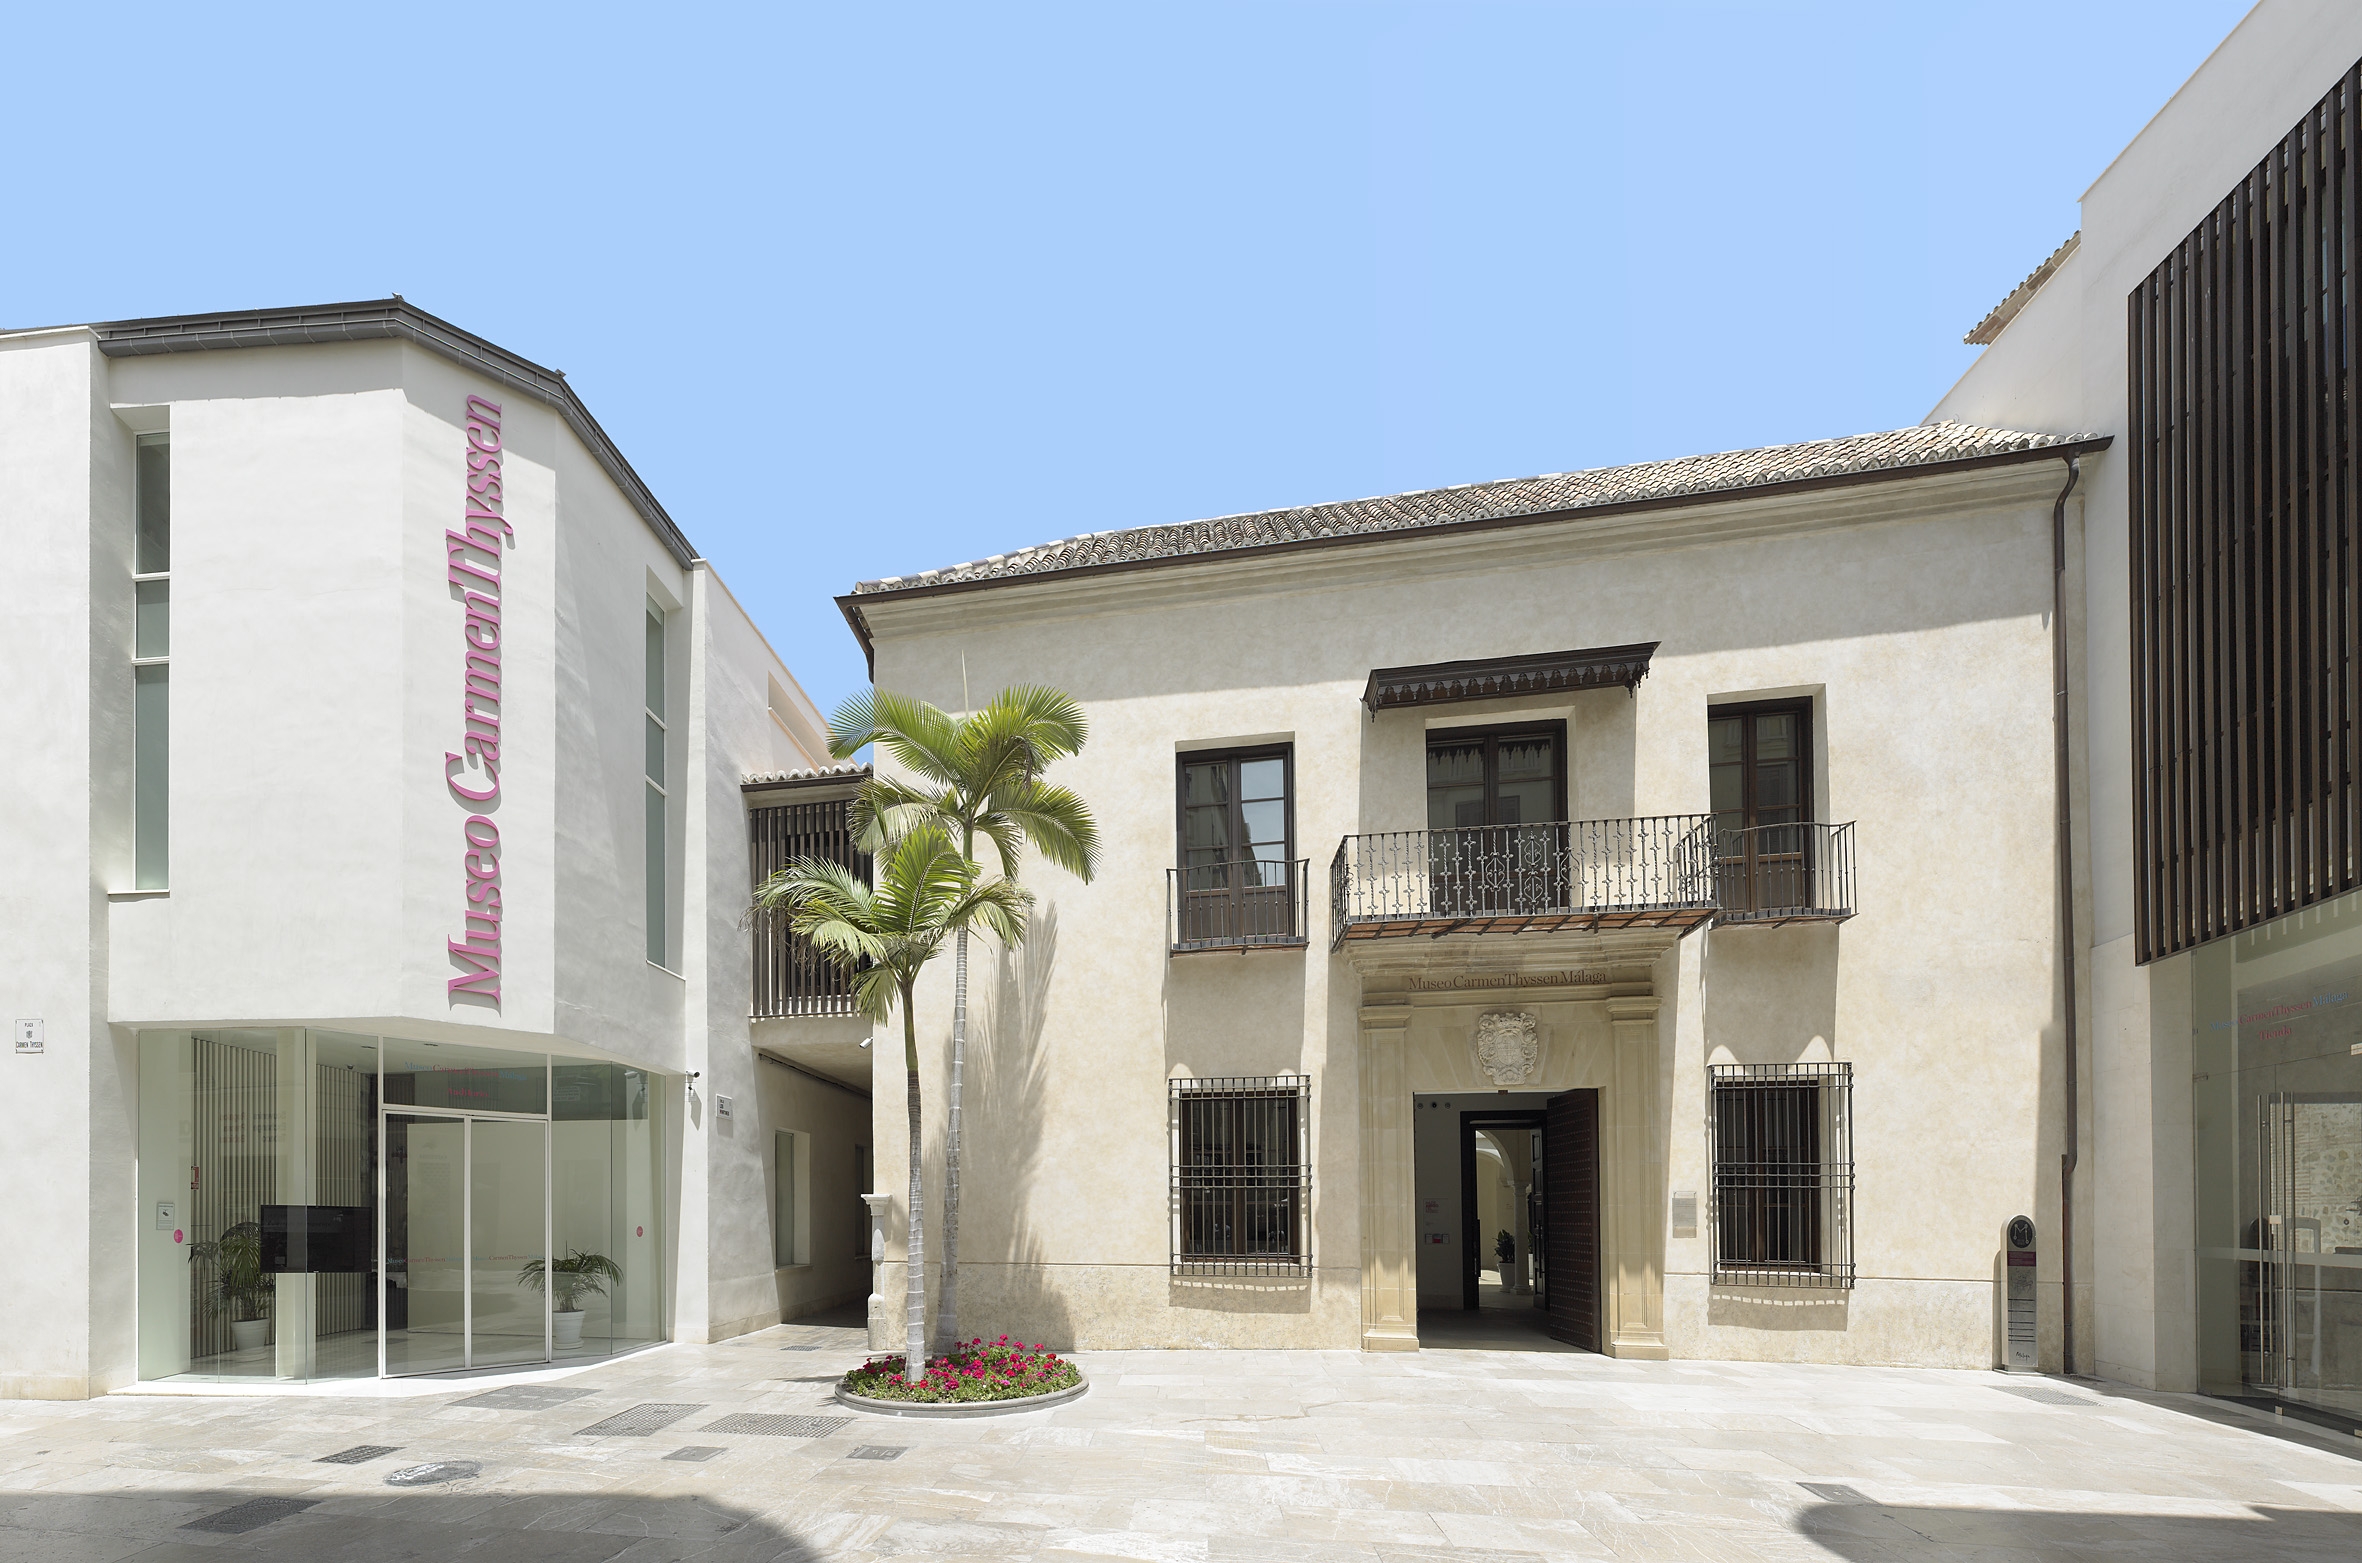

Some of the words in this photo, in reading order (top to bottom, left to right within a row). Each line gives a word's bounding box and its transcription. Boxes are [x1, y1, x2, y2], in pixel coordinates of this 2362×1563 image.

[1409, 977, 1452, 990] Museo
[1560, 970, 1606, 985] Málaga
[2258, 1025, 2293, 1041] Tienda
